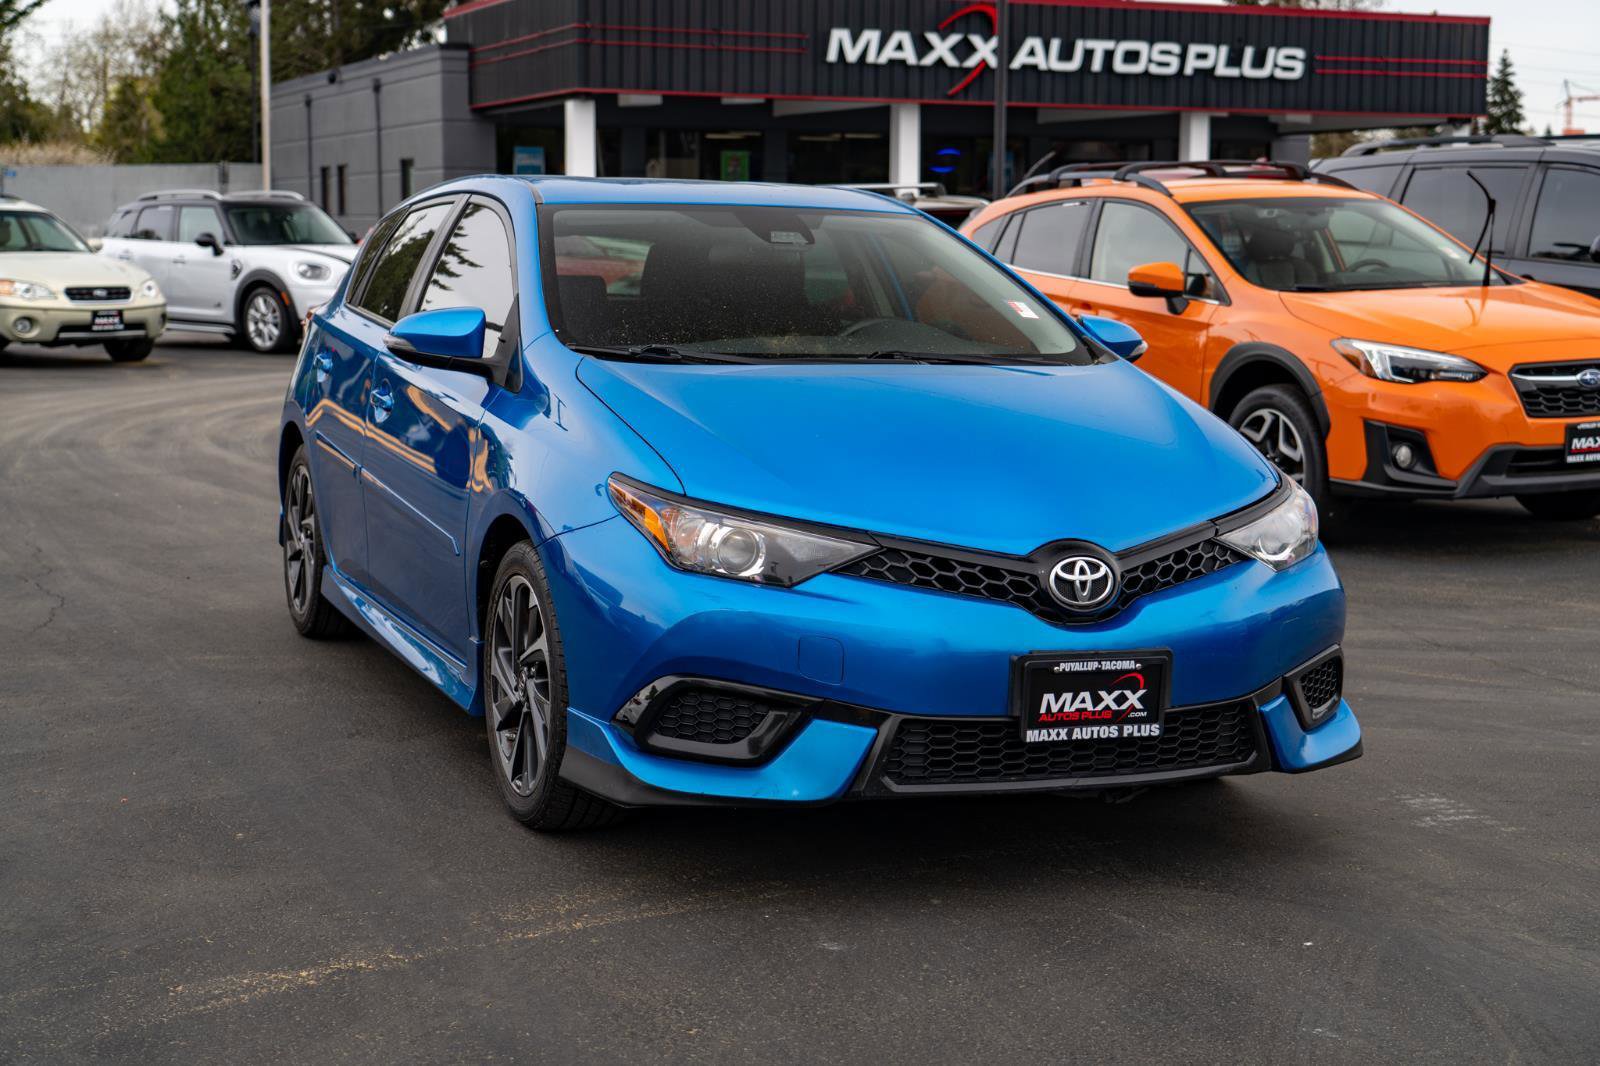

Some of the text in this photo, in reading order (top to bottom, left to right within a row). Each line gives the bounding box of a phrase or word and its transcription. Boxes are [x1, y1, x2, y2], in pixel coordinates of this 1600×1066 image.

[825, 27, 1306, 80] MAXX AUTOS PLUS
[1039, 689, 1148, 714] MAXX
[1038, 709, 1112, 722] AUTOS PLUS
[1026, 724, 1160, 743] MAXX AUTOS PLUS
